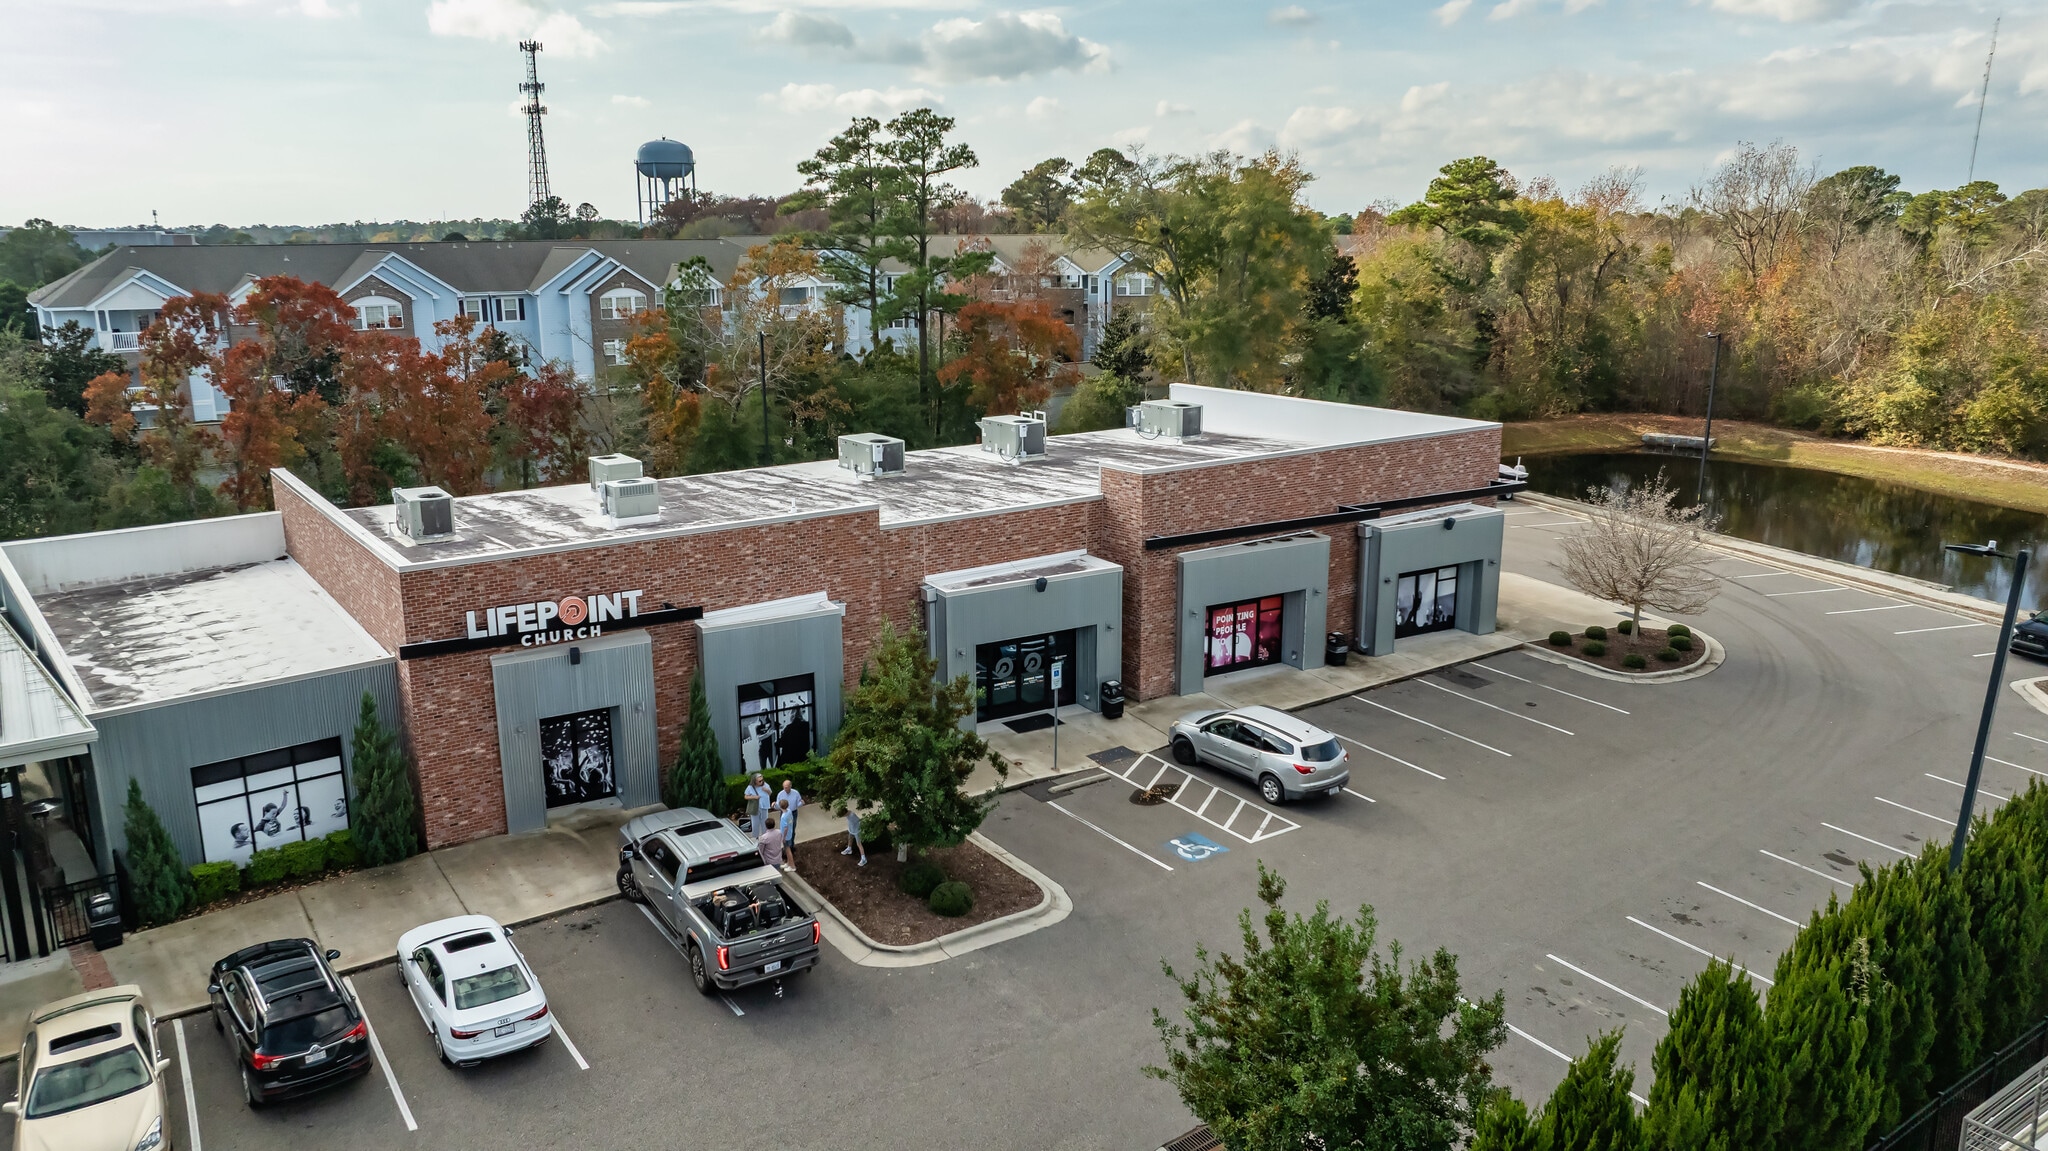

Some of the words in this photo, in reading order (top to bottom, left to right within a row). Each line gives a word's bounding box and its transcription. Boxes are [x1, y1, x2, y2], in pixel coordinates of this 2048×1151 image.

[466, 589, 643, 640] LIFEPOINT
[1216, 610, 1254, 624] POINTING
[520, 625, 602, 647] CHURCH
